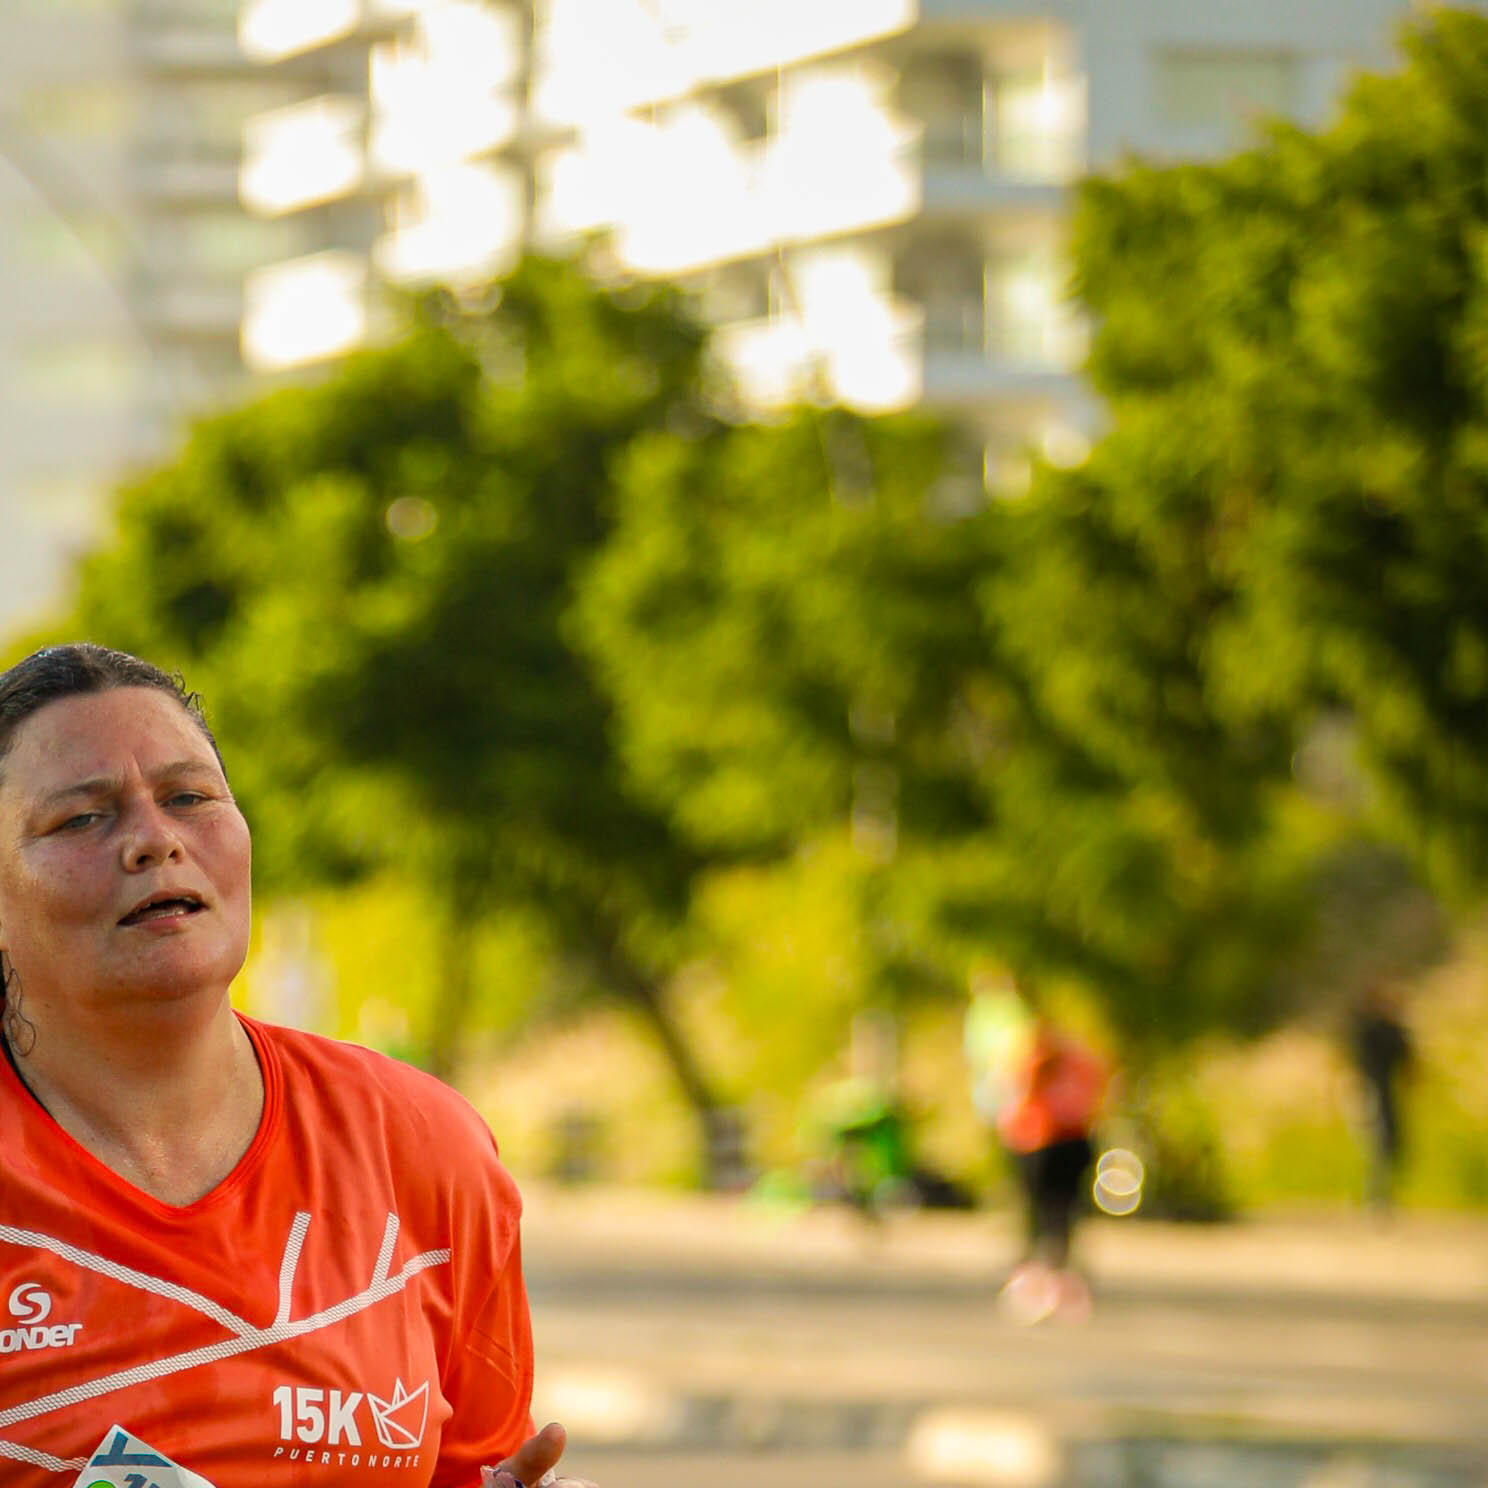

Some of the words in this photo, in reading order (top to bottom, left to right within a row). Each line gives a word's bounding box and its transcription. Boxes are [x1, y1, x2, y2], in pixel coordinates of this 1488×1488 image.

[272, 1385, 363, 1447] 15K
[273, 1447, 360, 1466] PUERTO
[367, 1454, 420, 1468] NORTE
